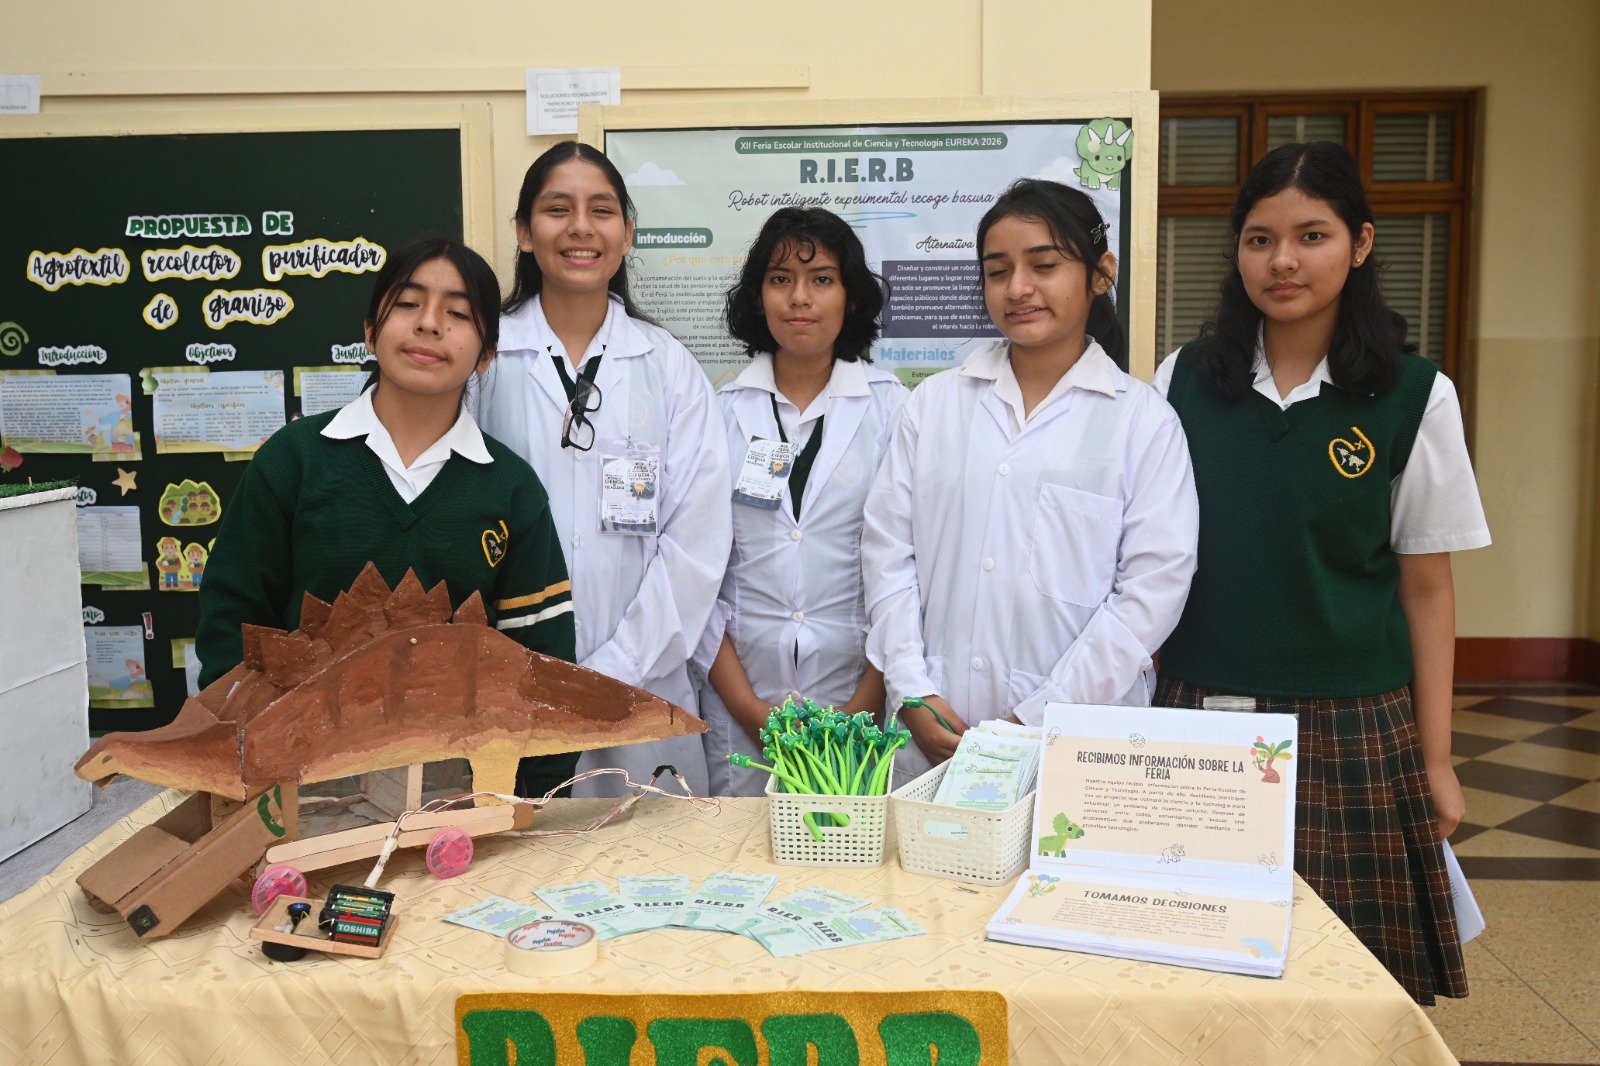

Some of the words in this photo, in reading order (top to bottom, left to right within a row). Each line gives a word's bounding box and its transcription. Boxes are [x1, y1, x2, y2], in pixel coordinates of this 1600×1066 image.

[740, 142, 751, 150] XII
[753, 142, 772, 150] Feria
[774, 141, 802, 149] Escolar
[804, 140, 851, 149] Institucional
[864, 140, 892, 148] Ciencia
[901, 139, 943, 149] Tecnología
[945, 138, 979, 147] EUREKA
[982, 138, 1002, 146] 2026
[800, 158, 914, 183] R.I.E.R.B
[728, 190, 770, 211] Robot
[770, 192, 832, 208] inteligente
[834, 190, 908, 210] experimental
[910, 193, 950, 209] recoge
[952, 190, 994, 203] basura
[128, 216, 249, 236] PROPUESTA
[265, 214, 291, 232] DE
[916, 235, 975, 253] Alternativa
[34, 253, 124, 285] Agrotextil
[147, 250, 236, 274] recolector
[269, 243, 382, 274] purificador
[150, 300, 174, 323] de
[208, 294, 287, 322] granizo
[880, 347, 955, 361] Materiales
[1076, 751, 1126, 765] RECIBIMOS
[1129, 755, 1195, 770] INFORMACIÓN
[1198, 759, 1229, 772] SOBRE
[1232, 761, 1244, 773] LA
[1145, 768, 1171, 780] FERIA
[1084, 890, 1148, 904] TOMAMOS
[1152, 898, 1227, 913] DECISIONES
[338, 924, 378, 935] TOSHIBA
